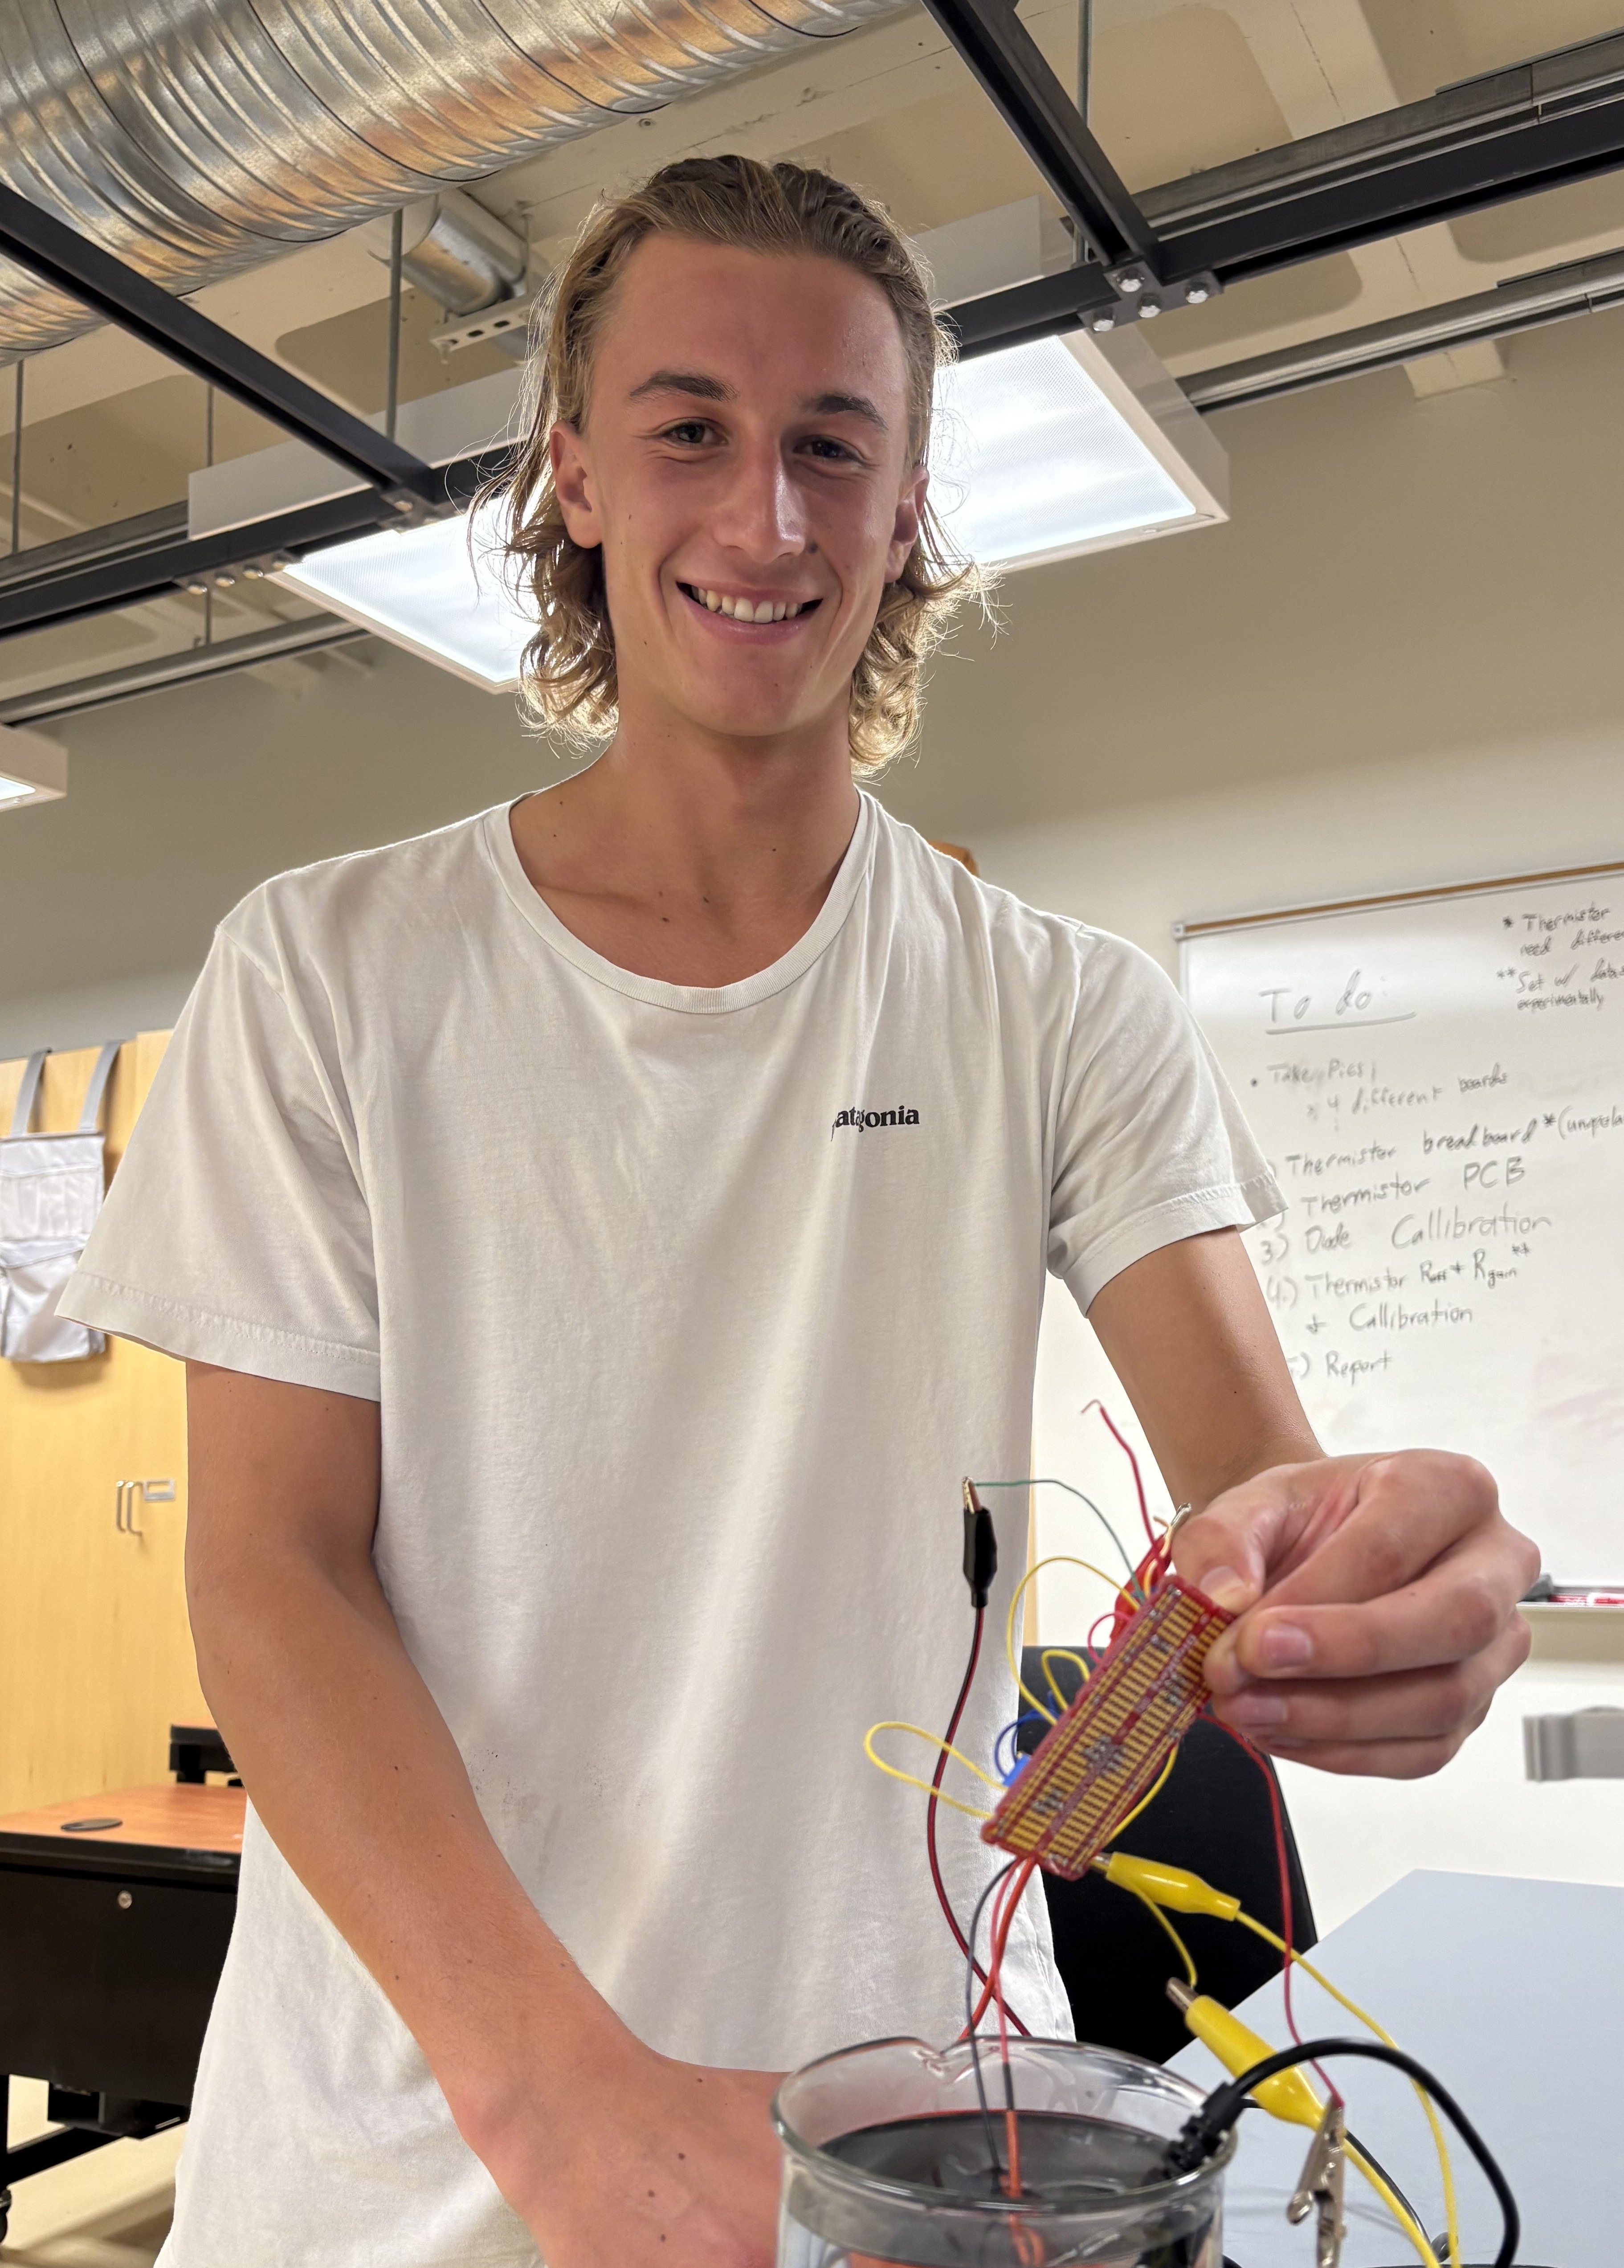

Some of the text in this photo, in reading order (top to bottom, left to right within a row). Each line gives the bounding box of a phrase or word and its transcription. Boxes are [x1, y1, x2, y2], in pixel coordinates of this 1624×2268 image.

[1571, 928, 1624, 950] differe
[1258, 987, 1311, 1023] To
[1351, 1085, 1444, 1115] different
[1300, 1155, 1525, 1217] Thermistor PCB
[1304, 1267, 1407, 1301] Thermistor
[1325, 1349, 1393, 1386] Report
